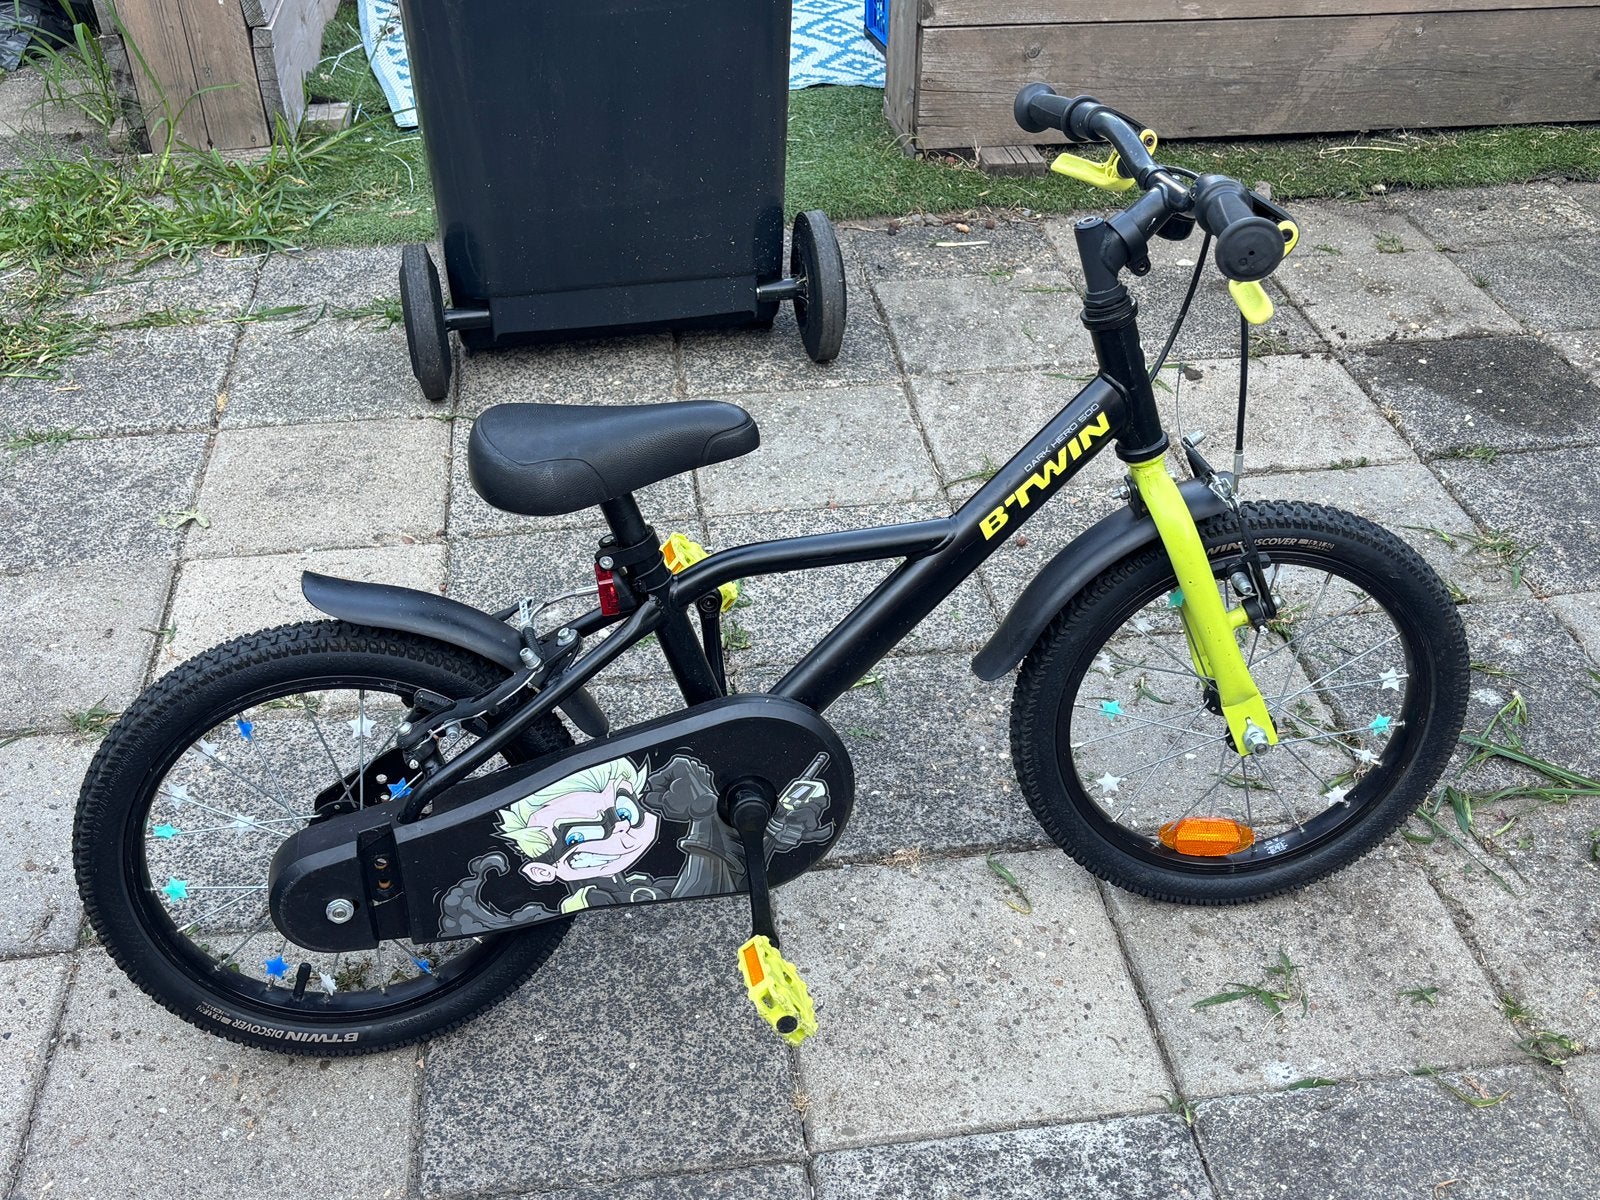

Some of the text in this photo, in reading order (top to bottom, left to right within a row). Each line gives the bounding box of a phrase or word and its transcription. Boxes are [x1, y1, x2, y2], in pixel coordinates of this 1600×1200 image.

[1024, 403, 1100, 473] DARK HERO 500
[232, 1018, 285, 1039] DISCOVER
